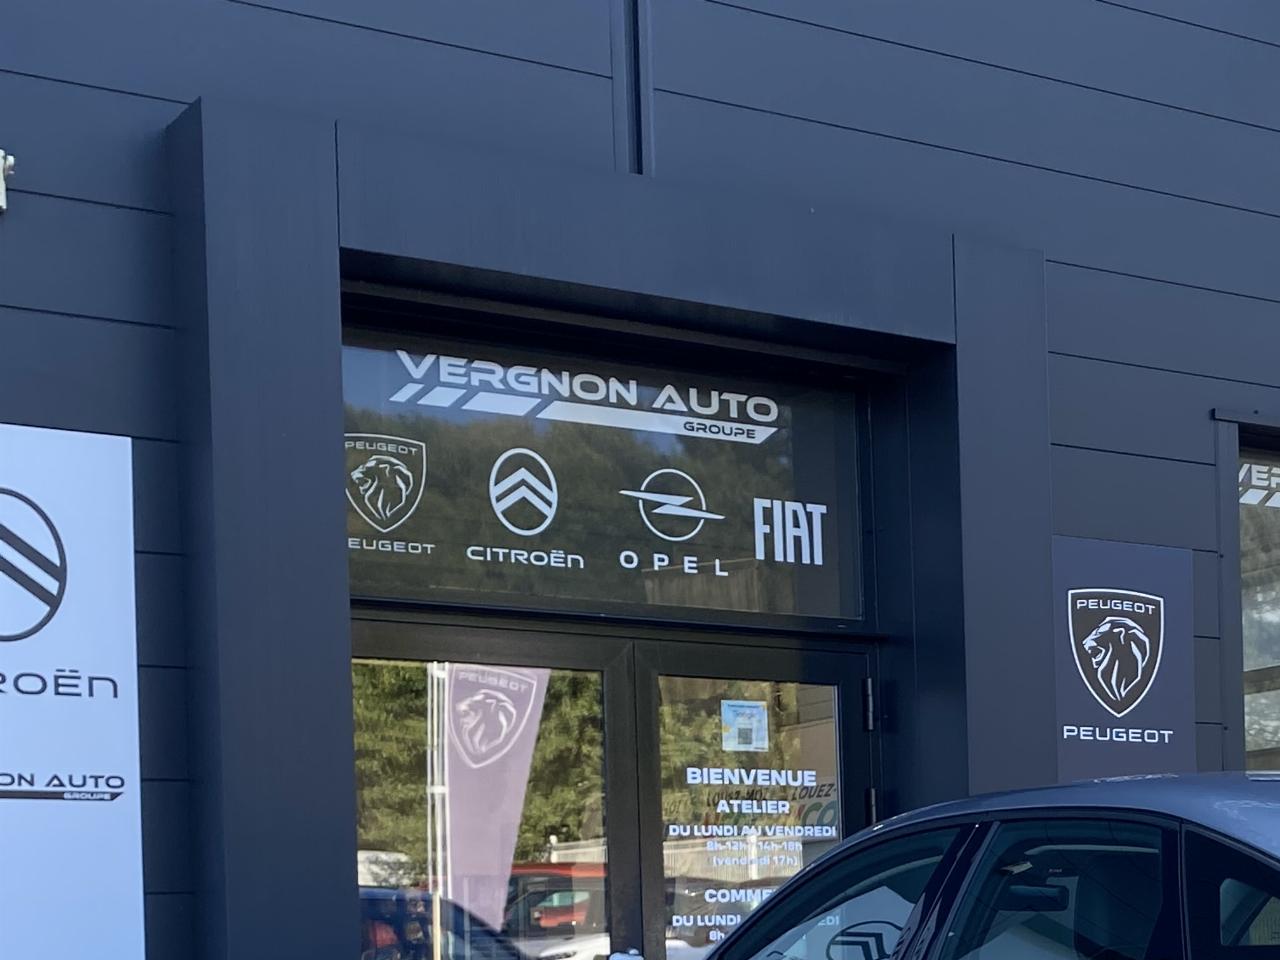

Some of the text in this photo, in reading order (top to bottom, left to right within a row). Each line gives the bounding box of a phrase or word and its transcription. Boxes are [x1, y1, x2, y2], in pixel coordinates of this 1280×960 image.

[396, 349, 779, 423] VERGNON AUTO
[683, 421, 757, 440] GROUPE
[344, 440, 419, 456] PEUGEOT
[753, 497, 827, 566] FIAT
[347, 537, 436, 555] EUGEOT
[619, 550, 729, 577] OPEL
[1075, 598, 1156, 616] PEUGEOT
[457, 671, 530, 693] PEUGEOT
[1063, 724, 1174, 744] PEUGEOT
[45, 773, 125, 789] AUTO
[686, 767, 816, 787] BIENVENUE
[716, 800, 790, 815] ATELIER
[669, 824, 690, 836] DU
[694, 825, 738, 837] LUNDI
[765, 825, 837, 837] VENDREDI
[672, 914, 742, 927] DU LUNDI
